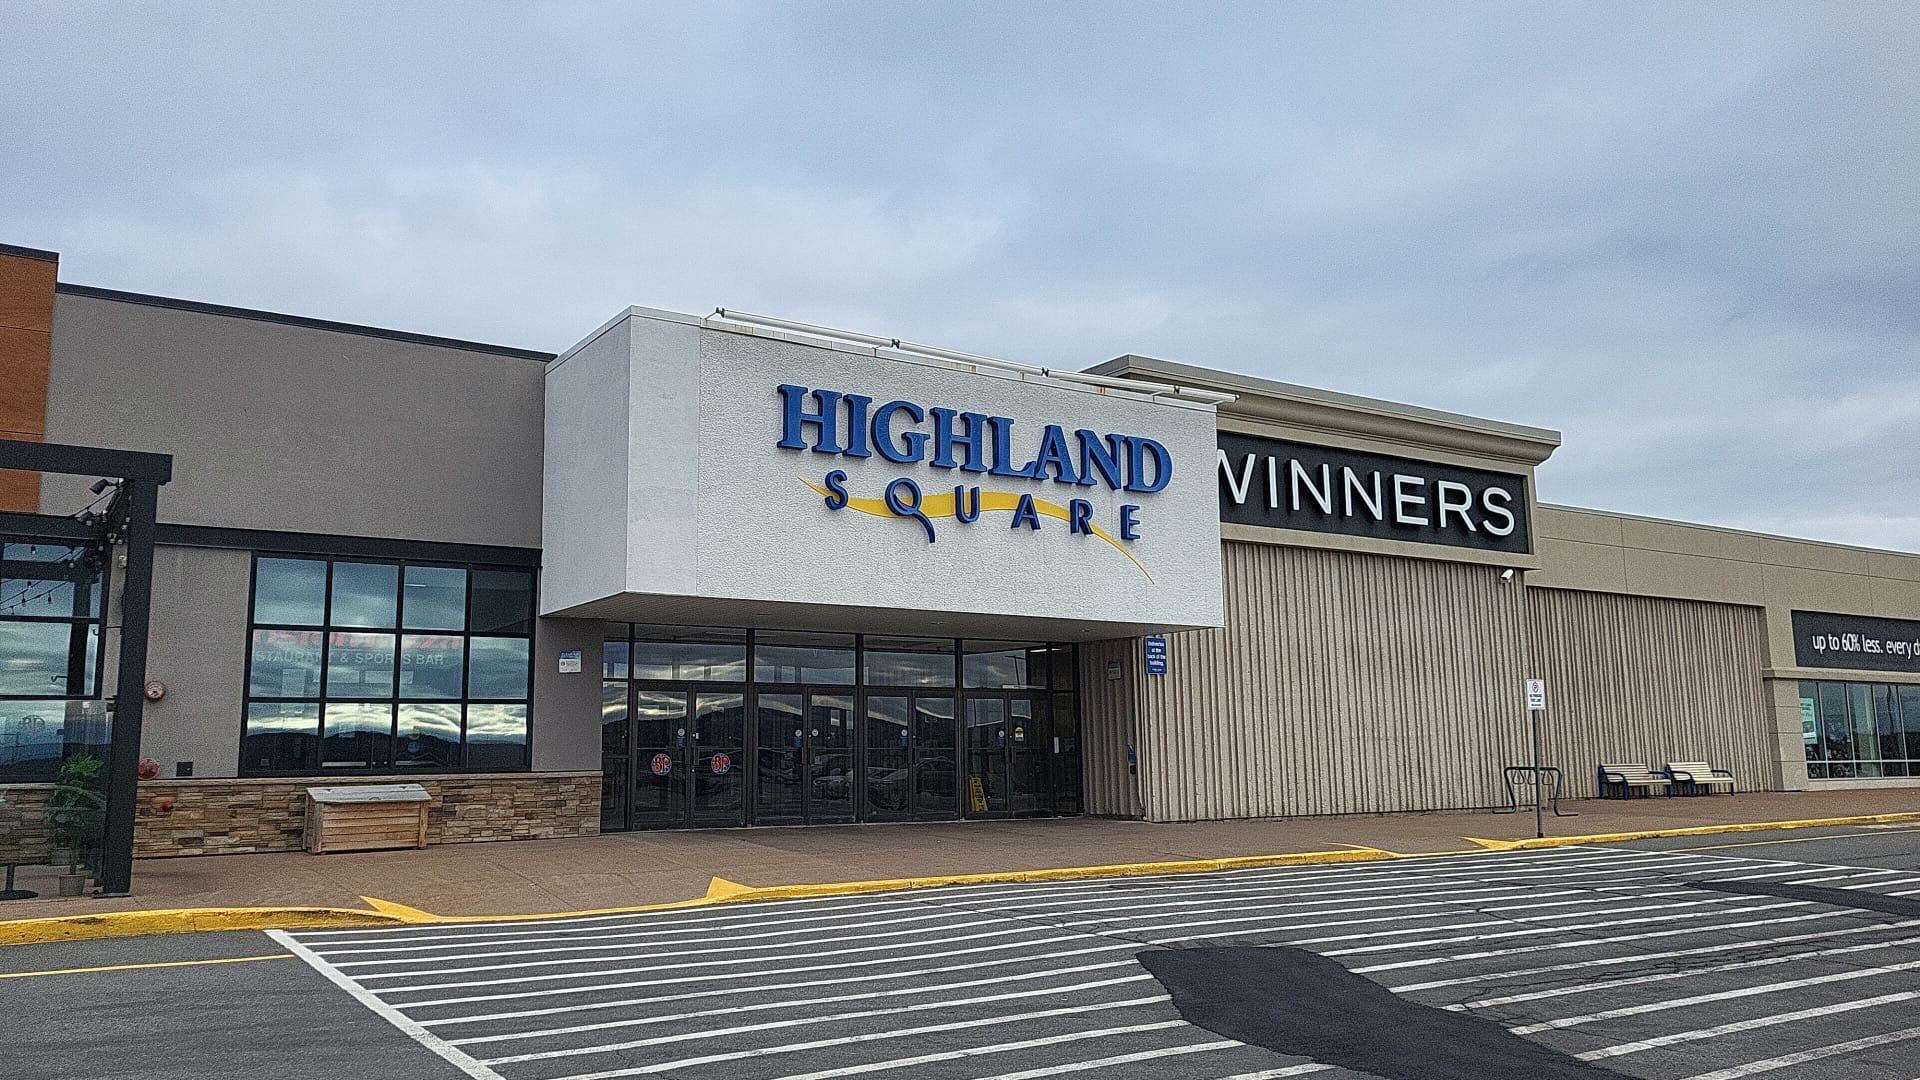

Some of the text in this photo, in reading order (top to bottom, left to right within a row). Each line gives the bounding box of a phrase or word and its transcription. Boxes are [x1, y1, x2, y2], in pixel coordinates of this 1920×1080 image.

[777, 384, 1173, 493] HIGHLAND
[824, 469, 1141, 543] SQUARE
[416, 654, 444, 665] BAR
[1812, 635, 1826, 654] up
[1828, 633, 1840, 650] to
[1842, 633, 1860, 651] 60%
[1862, 634, 1884, 653] less.
[1886, 640, 1912, 659] every
